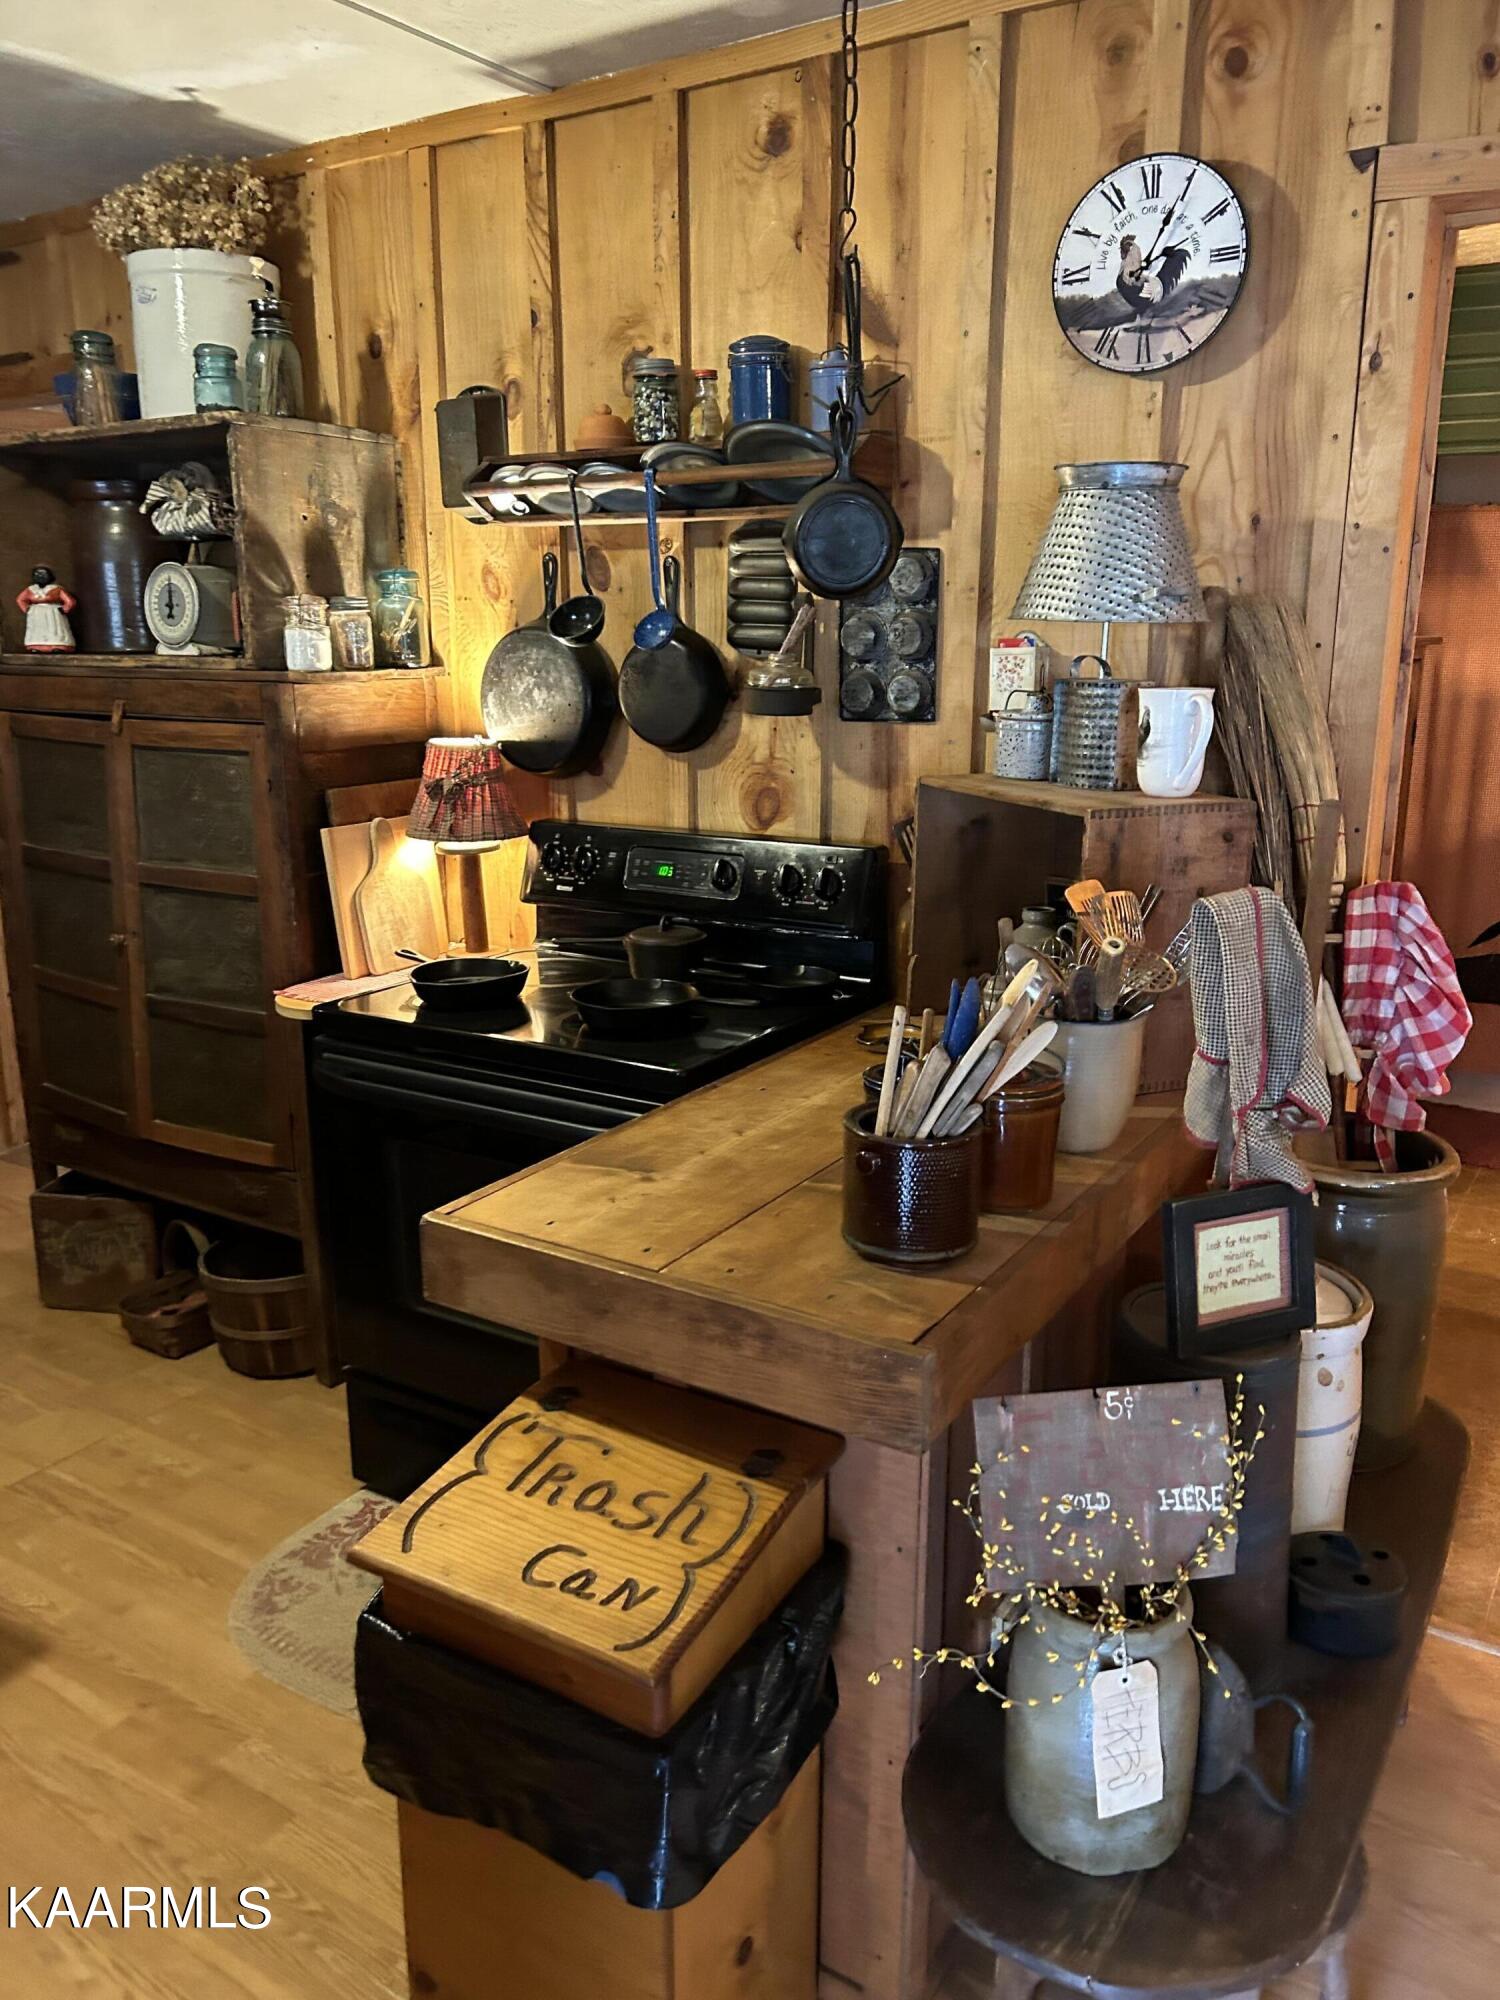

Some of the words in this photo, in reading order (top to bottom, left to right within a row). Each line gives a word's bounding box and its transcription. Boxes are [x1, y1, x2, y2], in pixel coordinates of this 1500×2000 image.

[1096, 250, 1109, 270] Live
[1104, 234, 1119, 247] by
[1206, 1239, 1221, 1251] Look
[1225, 1235, 1237, 1248] for
[1239, 1234, 1251, 1244] the
[1252, 1231, 1271, 1242] small
[1223, 1249, 1254, 1261] miracles
[1208, 1267, 1223, 1279] and
[1056, 1491, 1111, 1514] SOLD
[1157, 1482, 1226, 1512] HERE
[1101, 1687, 1148, 1791] HERBS
